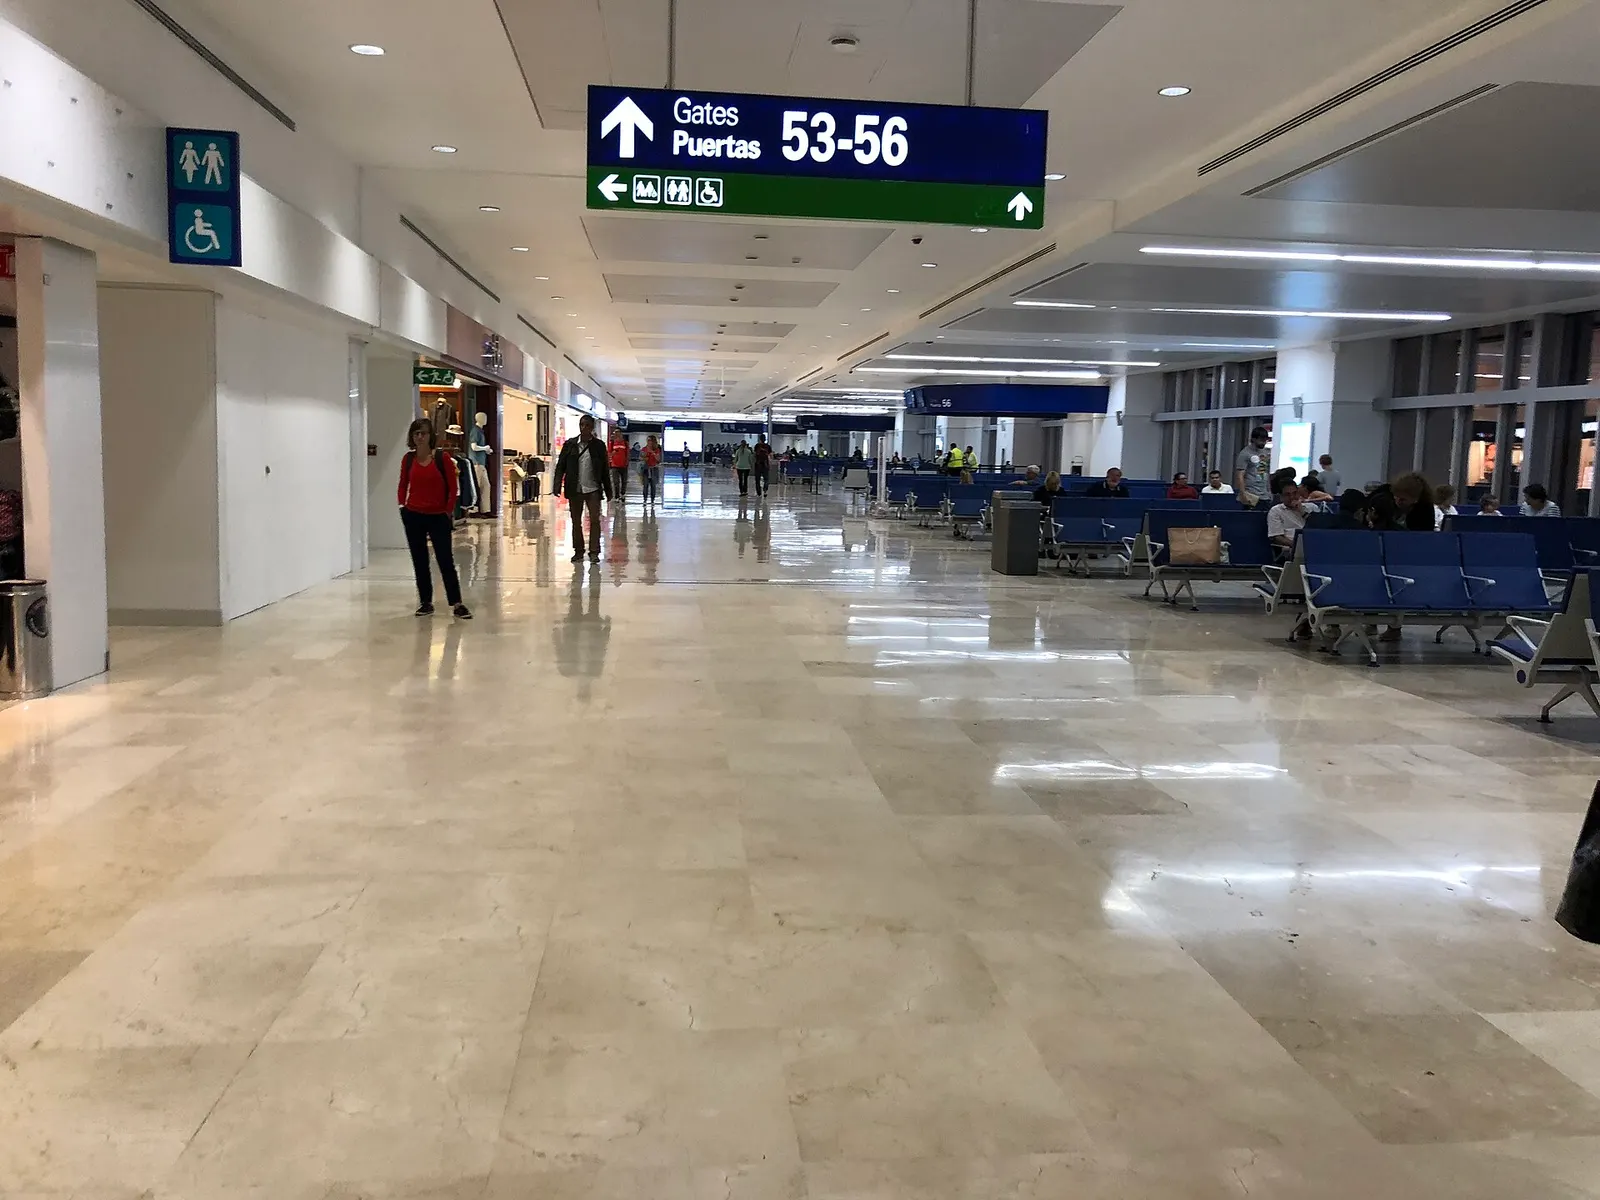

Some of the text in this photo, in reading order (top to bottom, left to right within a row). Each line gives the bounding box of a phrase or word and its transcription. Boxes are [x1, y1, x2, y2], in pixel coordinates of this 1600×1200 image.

[673, 97, 739, 128] Gates
[672, 129, 762, 160] Puertas
[781, 110, 909, 167] 53-56
